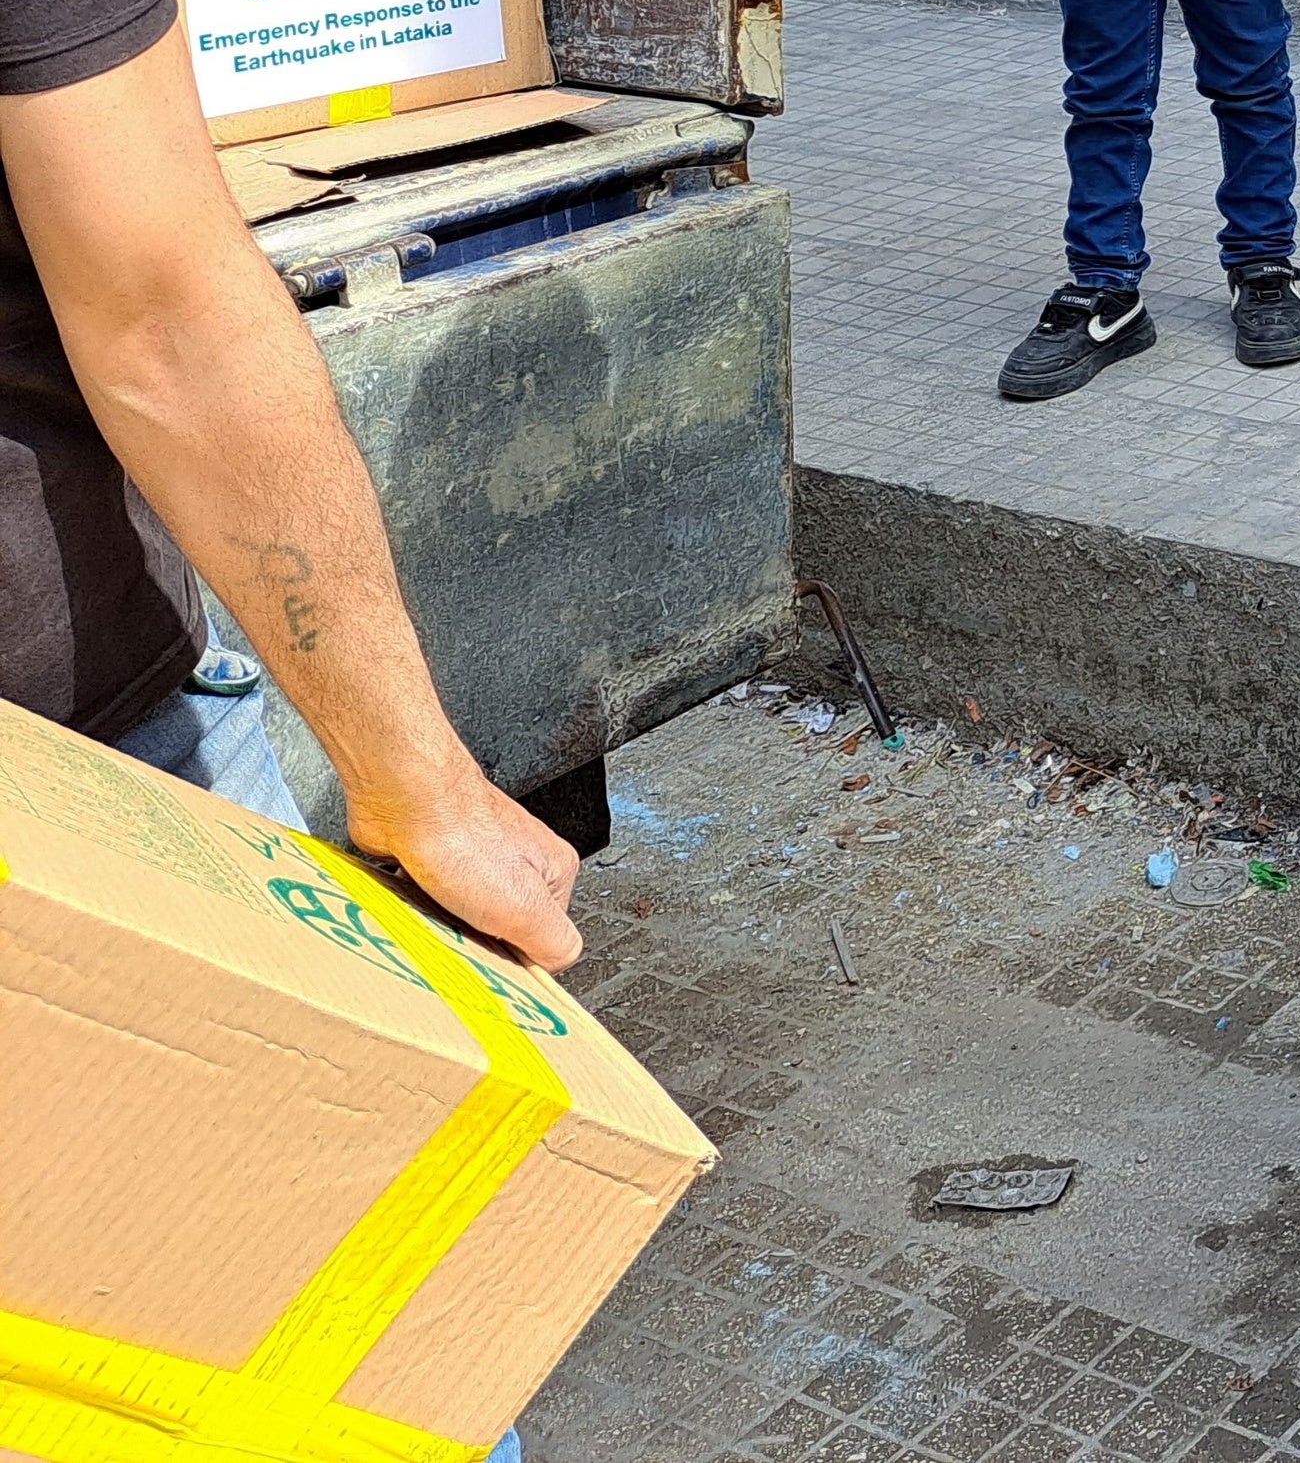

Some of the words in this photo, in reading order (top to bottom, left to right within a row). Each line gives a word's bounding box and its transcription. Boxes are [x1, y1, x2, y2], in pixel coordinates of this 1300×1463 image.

[199, 17, 320, 52] Emergency
[325, 0, 424, 33] Response
[233, 39, 355, 73] Earthquake
[359, 33, 378, 51] in
[381, 20, 453, 47] Latakia
